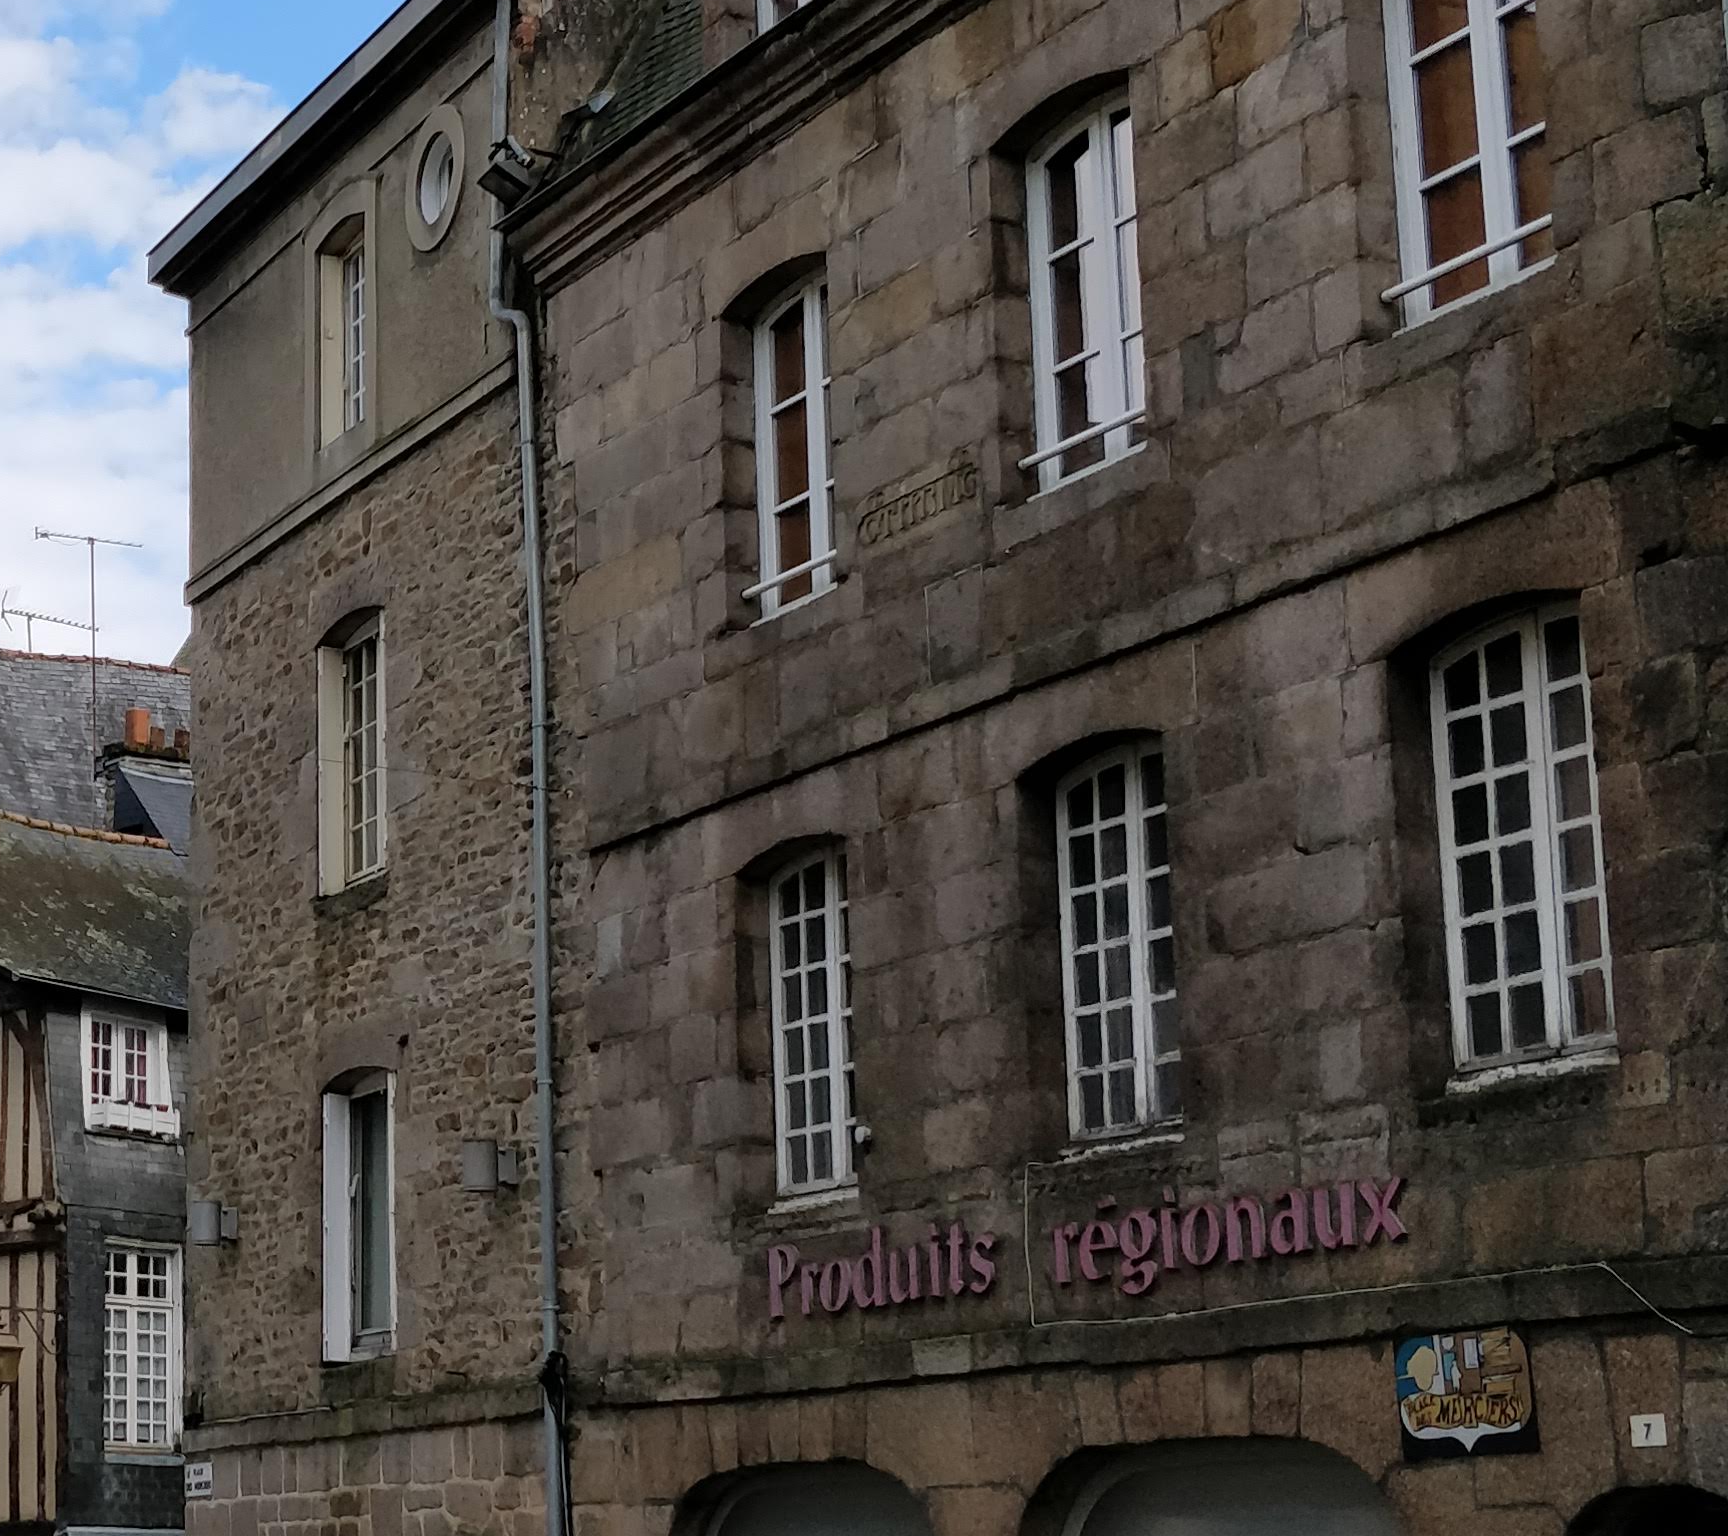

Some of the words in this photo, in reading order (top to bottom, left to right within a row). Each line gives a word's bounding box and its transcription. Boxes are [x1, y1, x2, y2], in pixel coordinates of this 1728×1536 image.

[768, 1222, 997, 1318] Produits
[1051, 1176, 1409, 1294] régionaux
[1436, 1395, 1518, 1425] MERCIERS
[1642, 1422, 1652, 1440] 7
